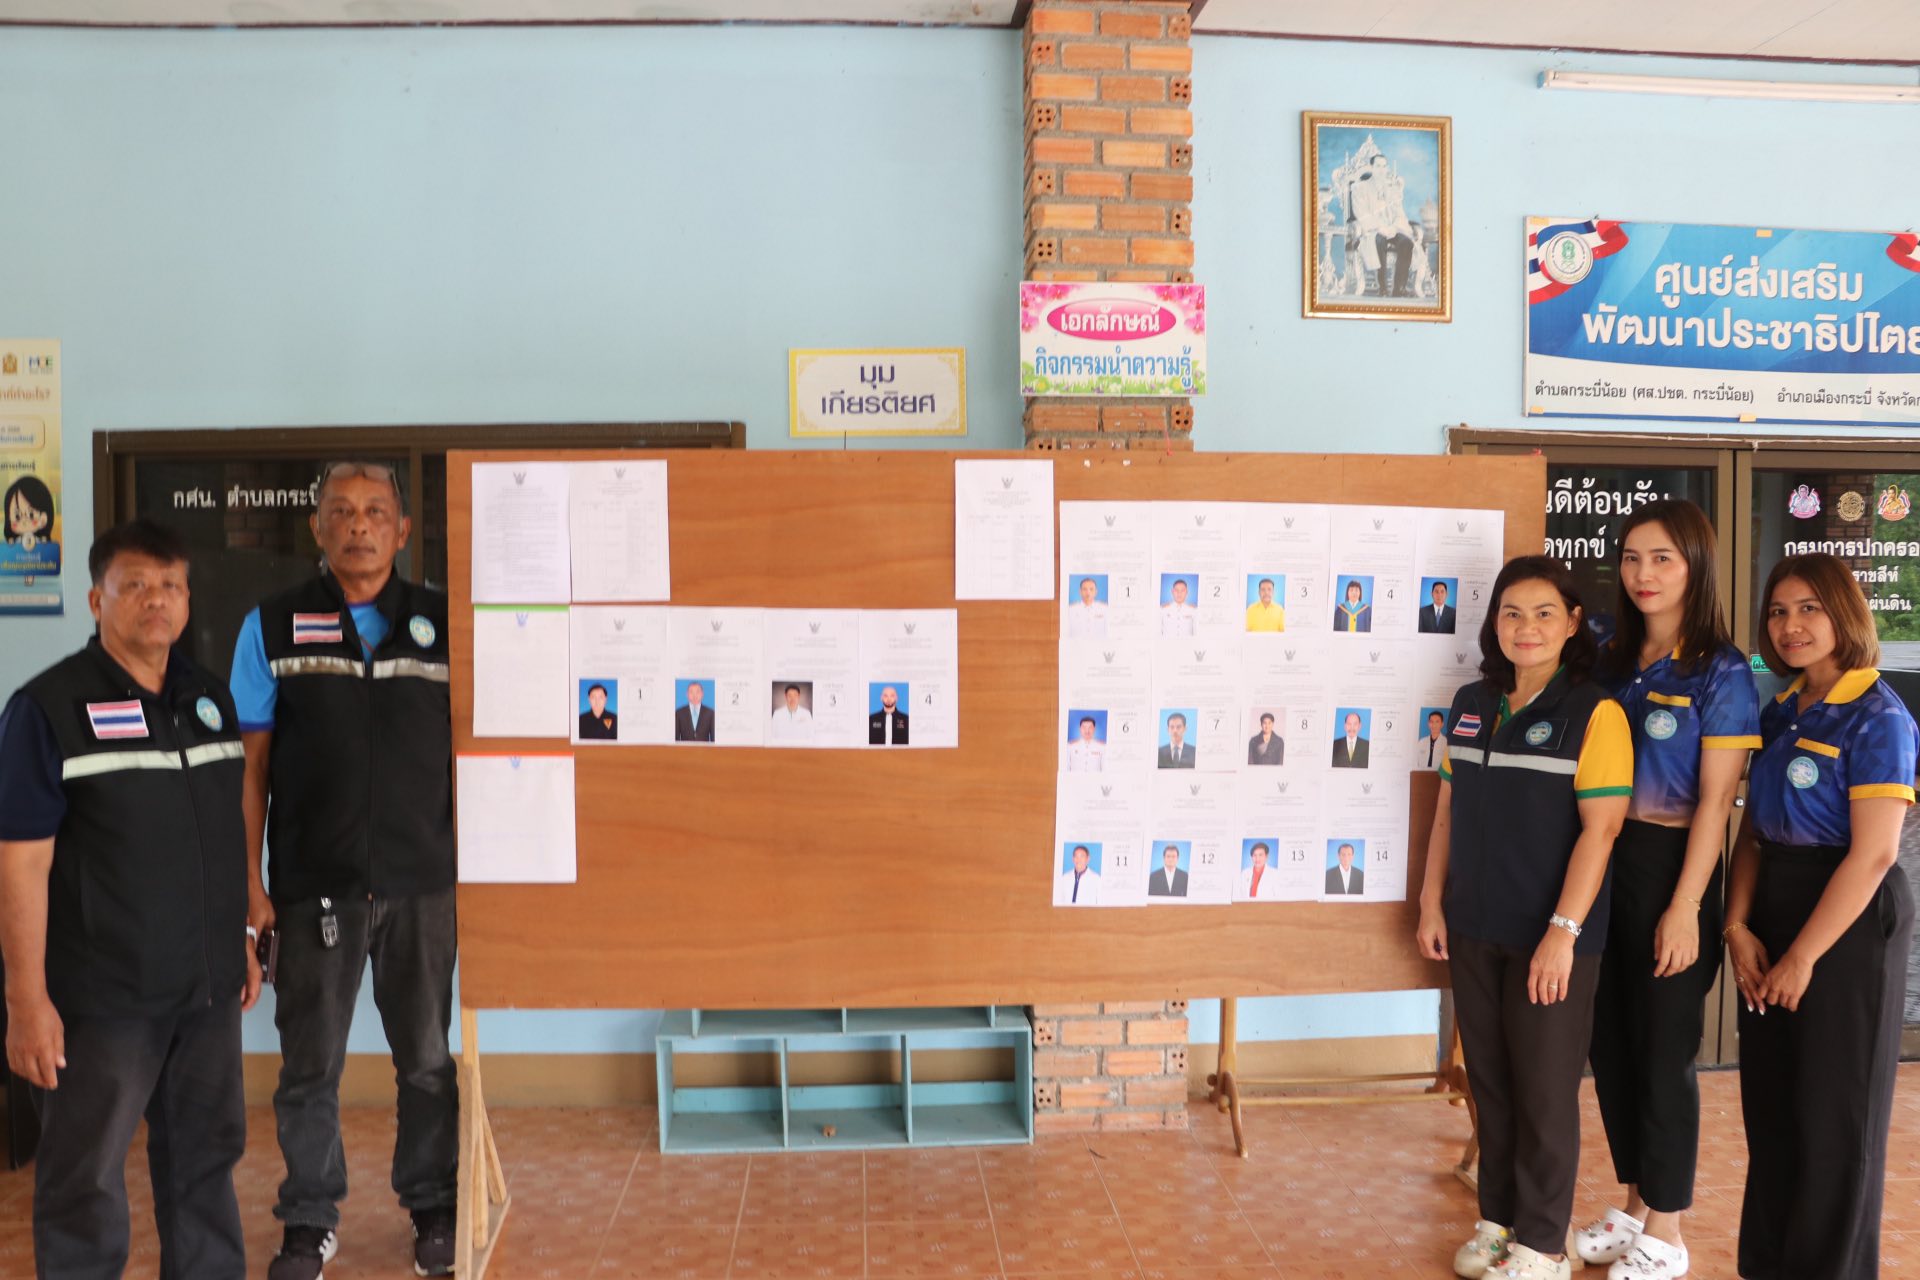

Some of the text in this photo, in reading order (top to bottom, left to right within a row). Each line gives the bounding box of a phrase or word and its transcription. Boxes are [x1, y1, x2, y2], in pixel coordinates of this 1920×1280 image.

[1655, 253, 1864, 309] ศูนย์ส่งเสริม
[1060, 303, 1161, 333] เอกลักษณ์
[1035, 345, 1193, 389] กิจกรรมนำความรู้
[860, 364, 896, 392] มุม
[1535, 379, 1627, 398] ตำบลกระบี่น้อย
[1693, 382, 1755, 404] กระบี่น้อย)
[1777, 386, 1872, 406] อำเภอเมืองกระบี่
[821, 389, 936, 415] เกียรติยศ
[173, 486, 217, 508] กศน.
[1213, 585, 1221, 598] 2
[1301, 586, 1308, 598] 3
[1386, 588, 1394, 600] 4
[1472, 589, 1479, 601] 5
[1865, 593, 1912, 611] ผ่นดิน
[731, 692, 740, 706] 2
[829, 694, 837, 707] 3
[924, 693, 932, 706] 4
[1122, 723, 1130, 734] 6
[1213, 718, 1220, 731] 7
[1301, 718, 1308, 730] 8
[1385, 720, 1393, 732] 9
[1116, 855, 1128, 867] 11
[1201, 852, 1215, 865] 12
[1291, 850, 1305, 862] 13
[1376, 850, 1389, 862] 14
